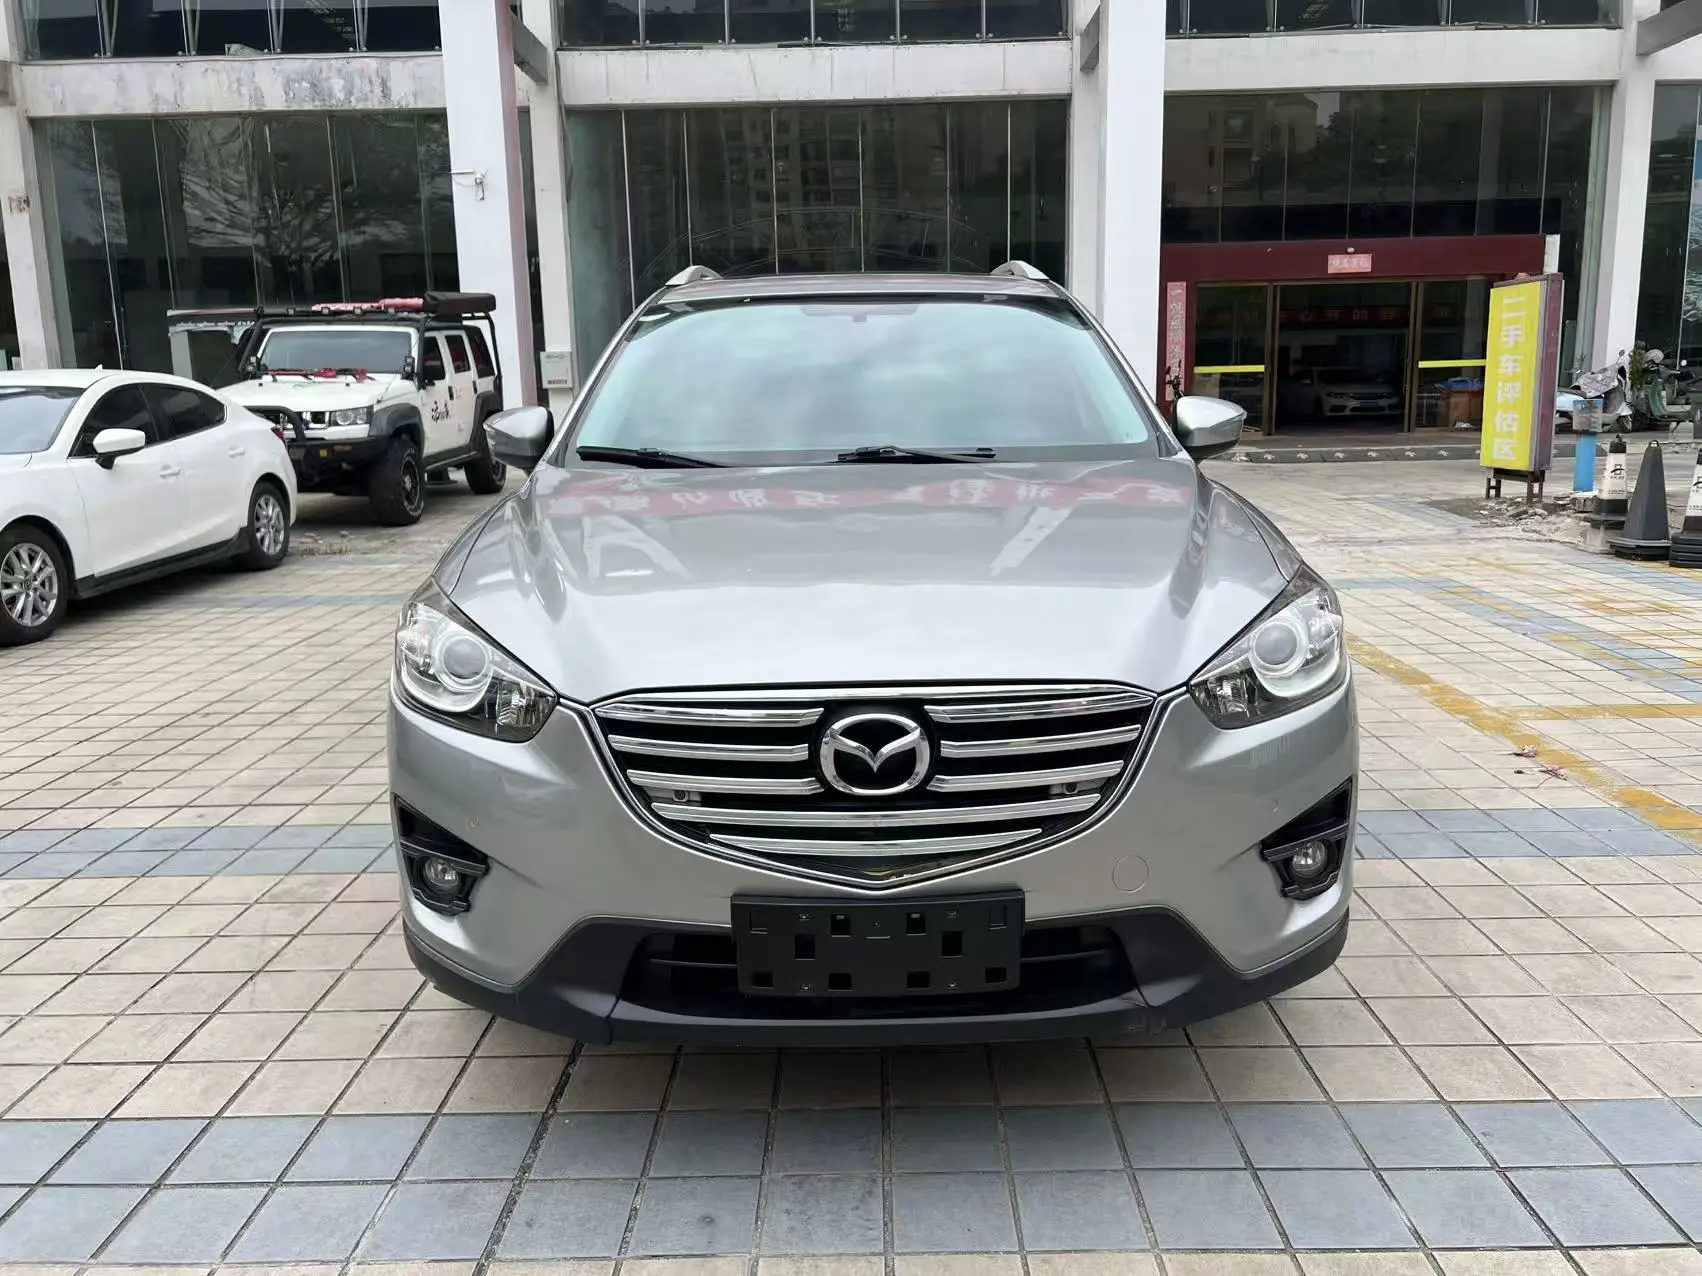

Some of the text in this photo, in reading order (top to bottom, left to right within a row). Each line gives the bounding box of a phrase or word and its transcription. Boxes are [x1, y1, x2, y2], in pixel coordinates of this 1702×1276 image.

[1493, 297, 1526, 460] 二手车评估区
